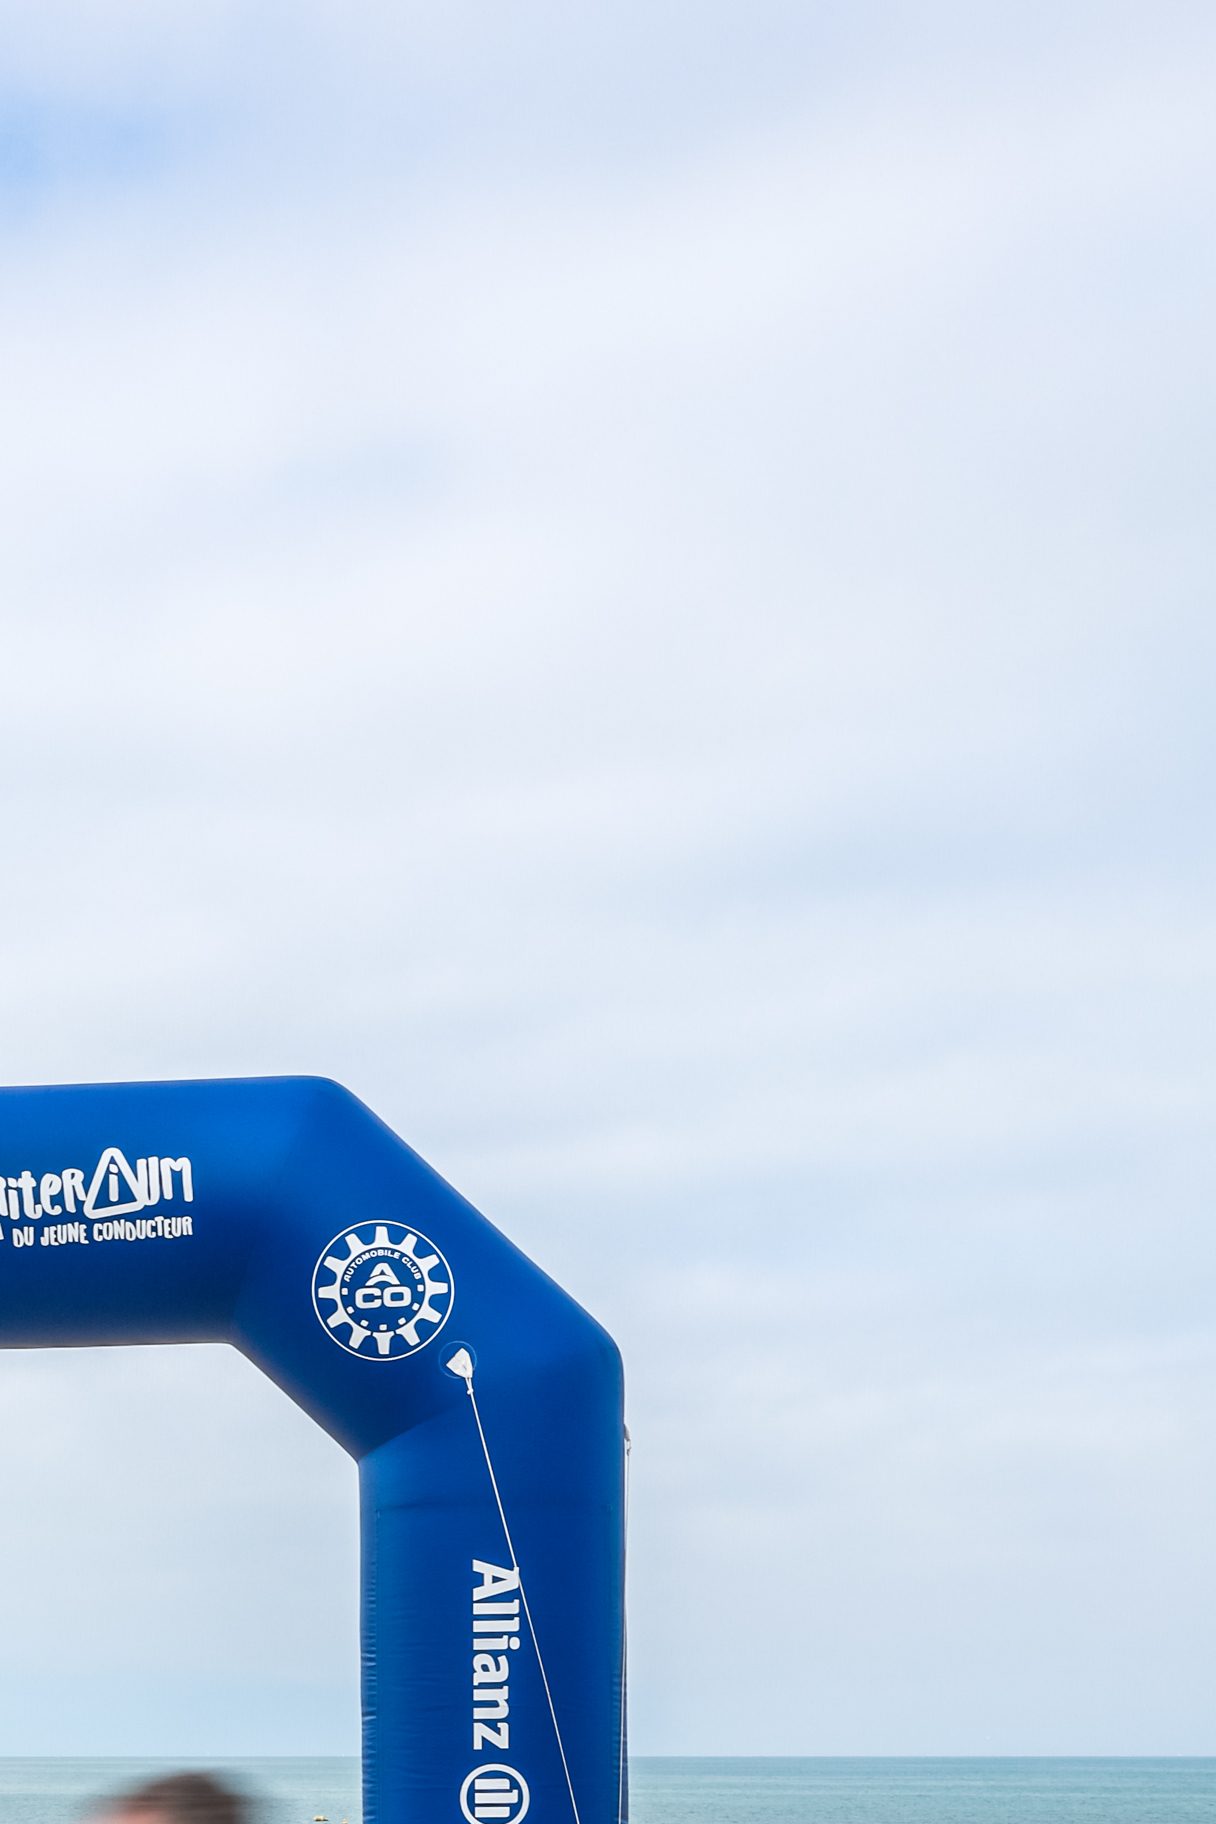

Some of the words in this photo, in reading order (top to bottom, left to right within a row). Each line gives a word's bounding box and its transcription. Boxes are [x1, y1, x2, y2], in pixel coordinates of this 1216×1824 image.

[12, 1225, 35, 1248] DU
[40, 1222, 89, 1247] JEUNE
[93, 1216, 194, 1242] CONDUCTEUR
[344, 1249, 402, 1282] AUTOMOBILE
[401, 1256, 422, 1280] CLUB
[471, 1558, 521, 1750] Allianz
